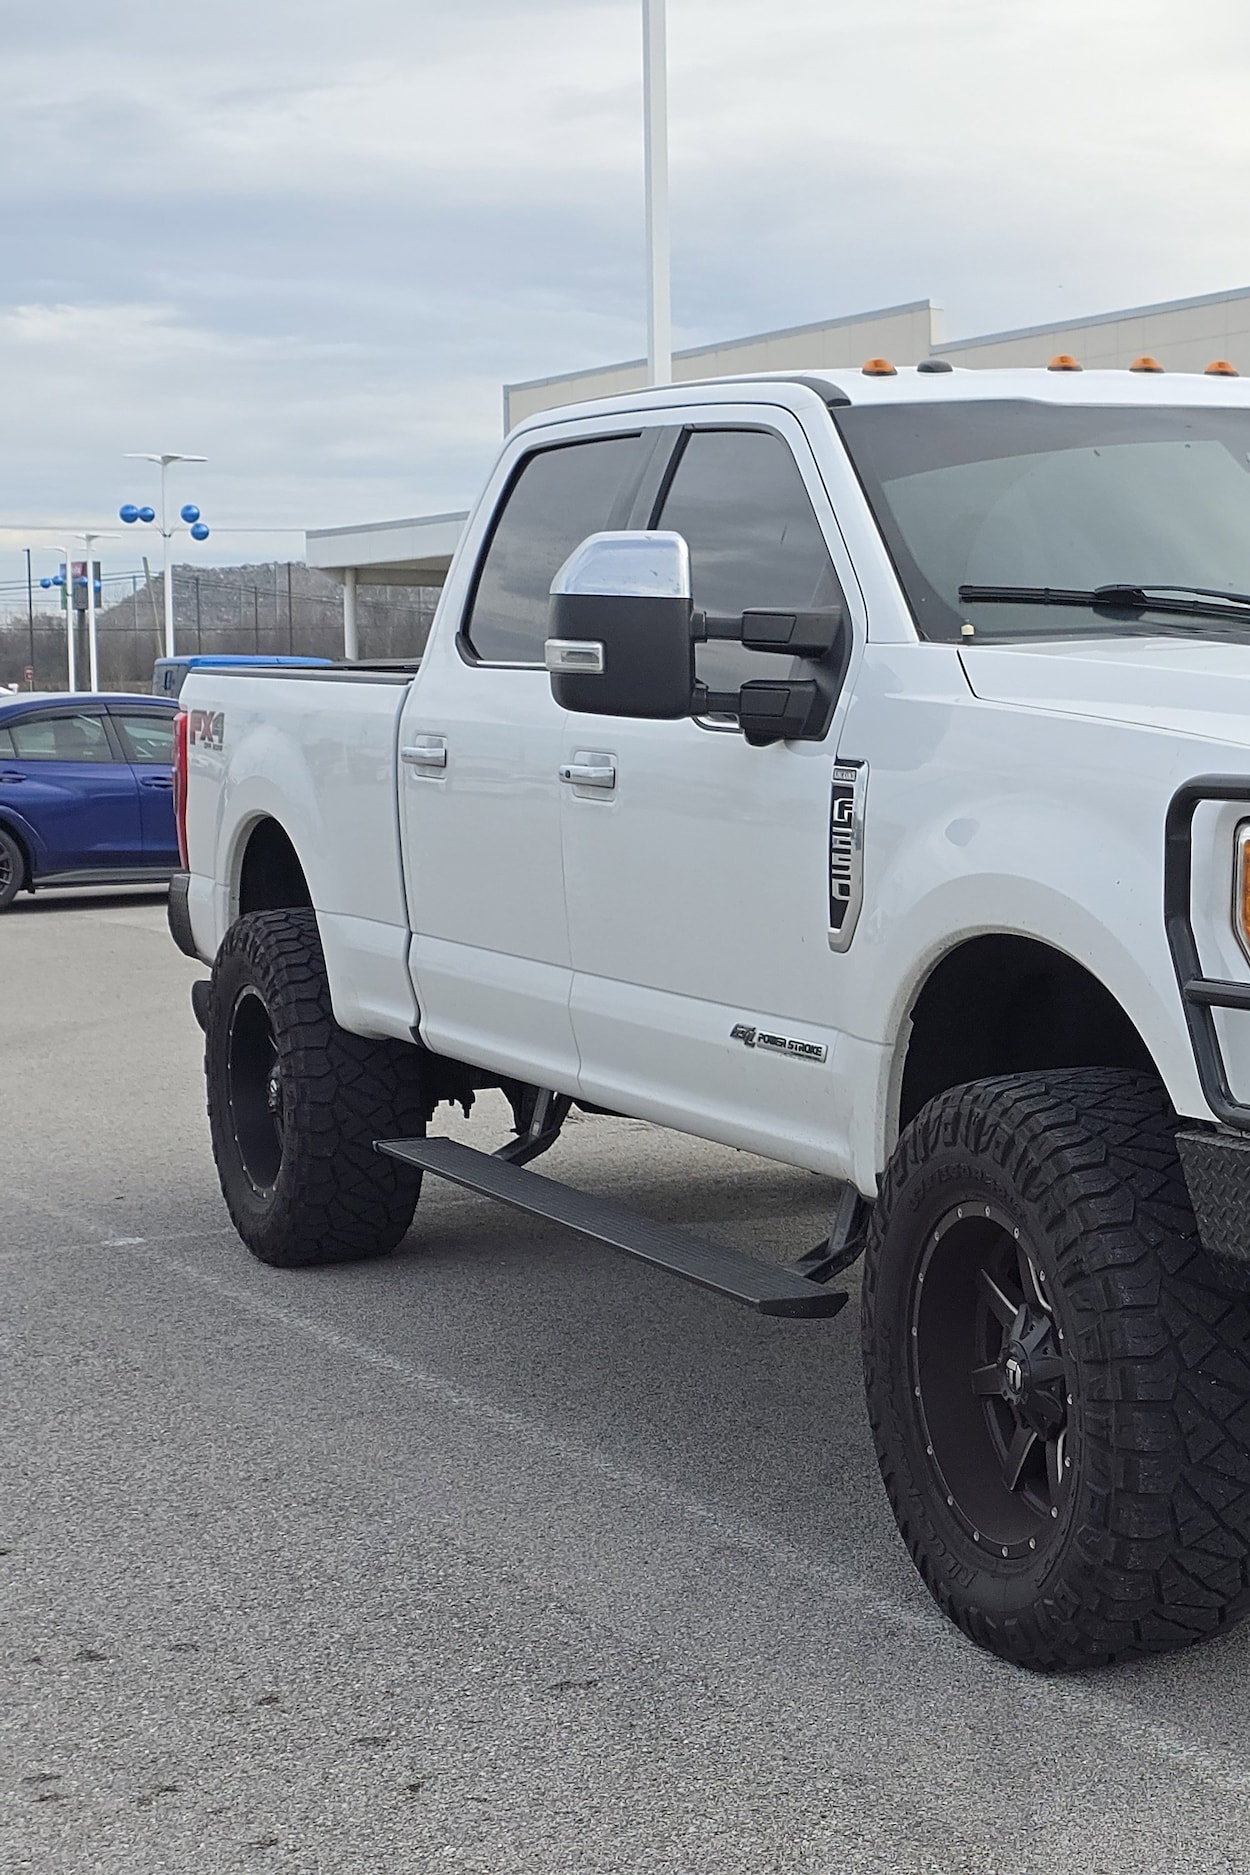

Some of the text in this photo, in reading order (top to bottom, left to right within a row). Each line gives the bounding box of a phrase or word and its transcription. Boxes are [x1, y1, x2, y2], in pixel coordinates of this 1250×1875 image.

[190, 709, 225, 746] FX4
[757, 1032, 787, 1049] POWER
[787, 1039, 823, 1057] STROKE
